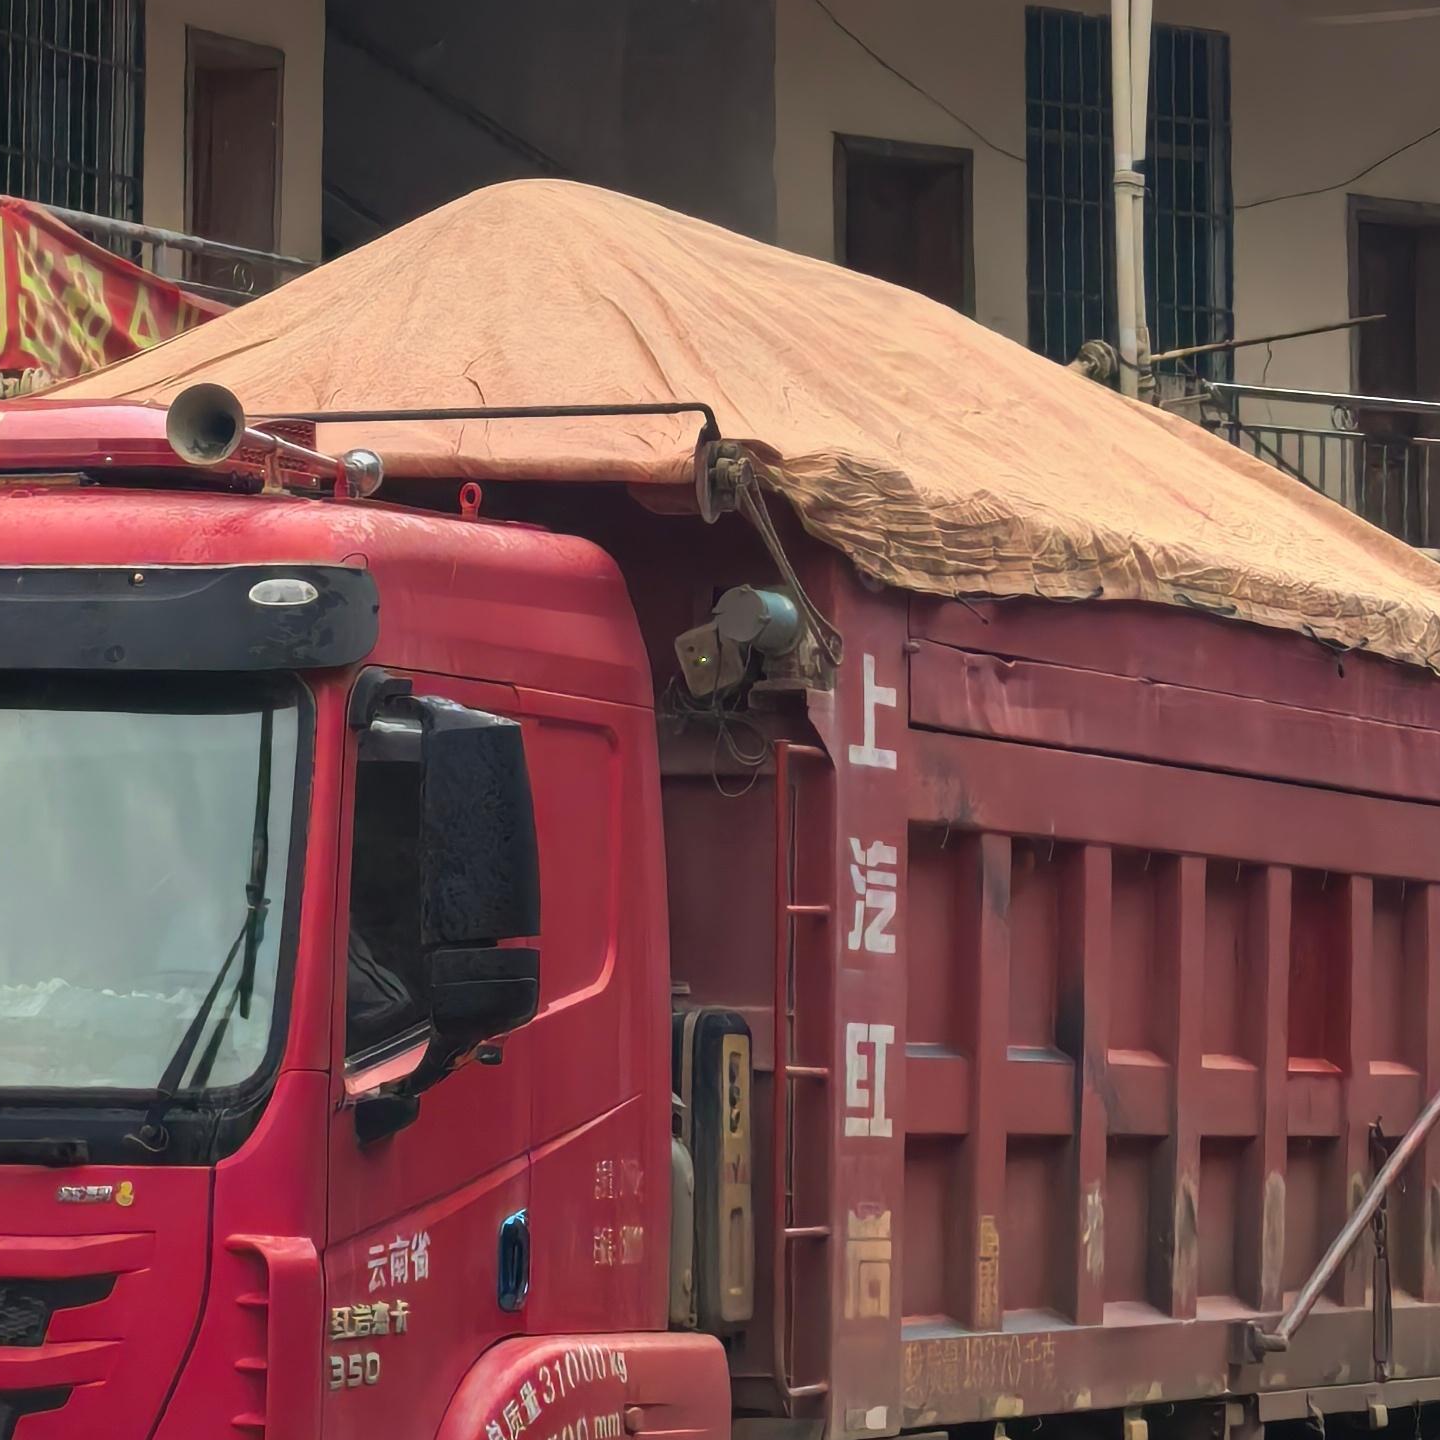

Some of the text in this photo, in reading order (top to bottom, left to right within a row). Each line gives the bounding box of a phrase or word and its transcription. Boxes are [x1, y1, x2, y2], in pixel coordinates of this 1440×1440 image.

[367, 1230, 432, 1293] 云南省
[329, 1351, 381, 1391] 350
